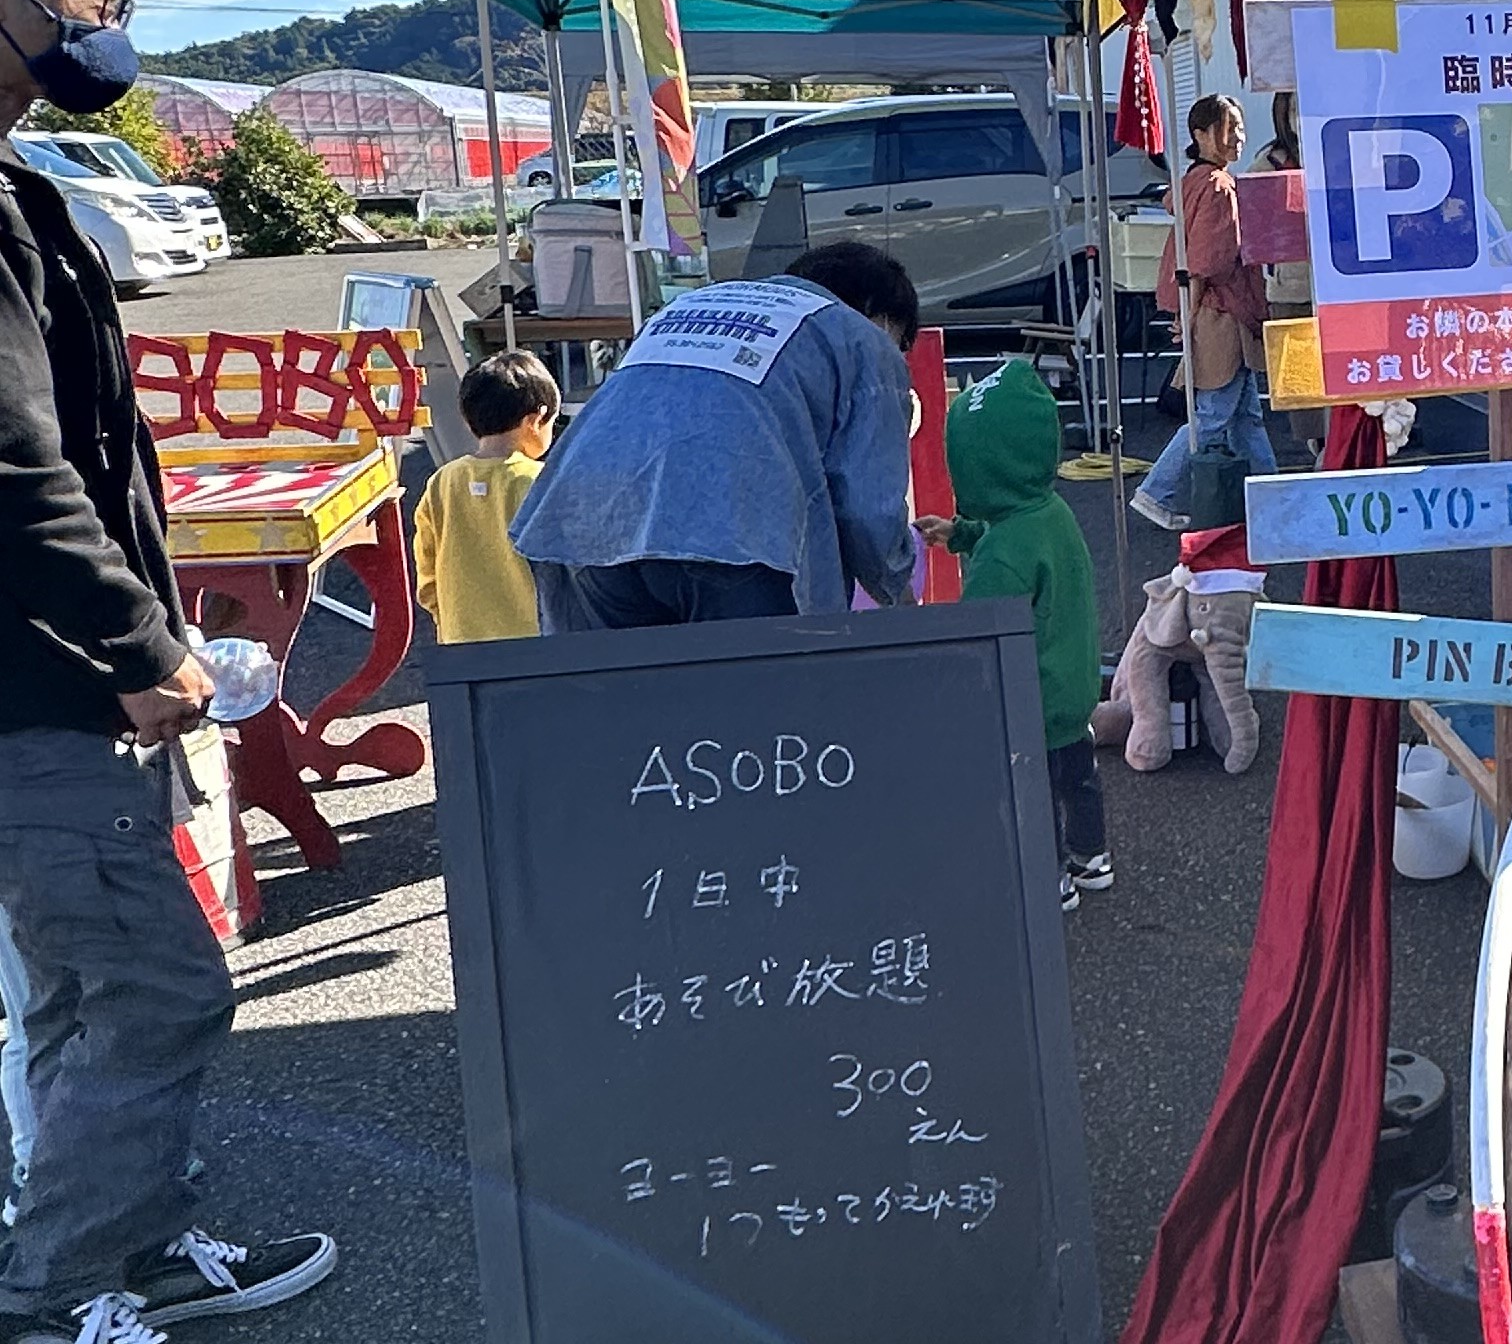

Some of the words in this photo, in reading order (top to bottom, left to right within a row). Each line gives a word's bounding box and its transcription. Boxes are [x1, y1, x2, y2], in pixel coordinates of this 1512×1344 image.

[1348, 127, 1454, 262] P
[1391, 635, 1473, 684] PIN
[630, 733, 856, 810] ASOBO
[641, 854, 800, 919] 1日中
[613, 932, 936, 1030] あそび放題
[828, 1053, 933, 1118] 300
[907, 1107, 989, 1144] えん
[619, 1156, 778, 1201] ヨーヨー
